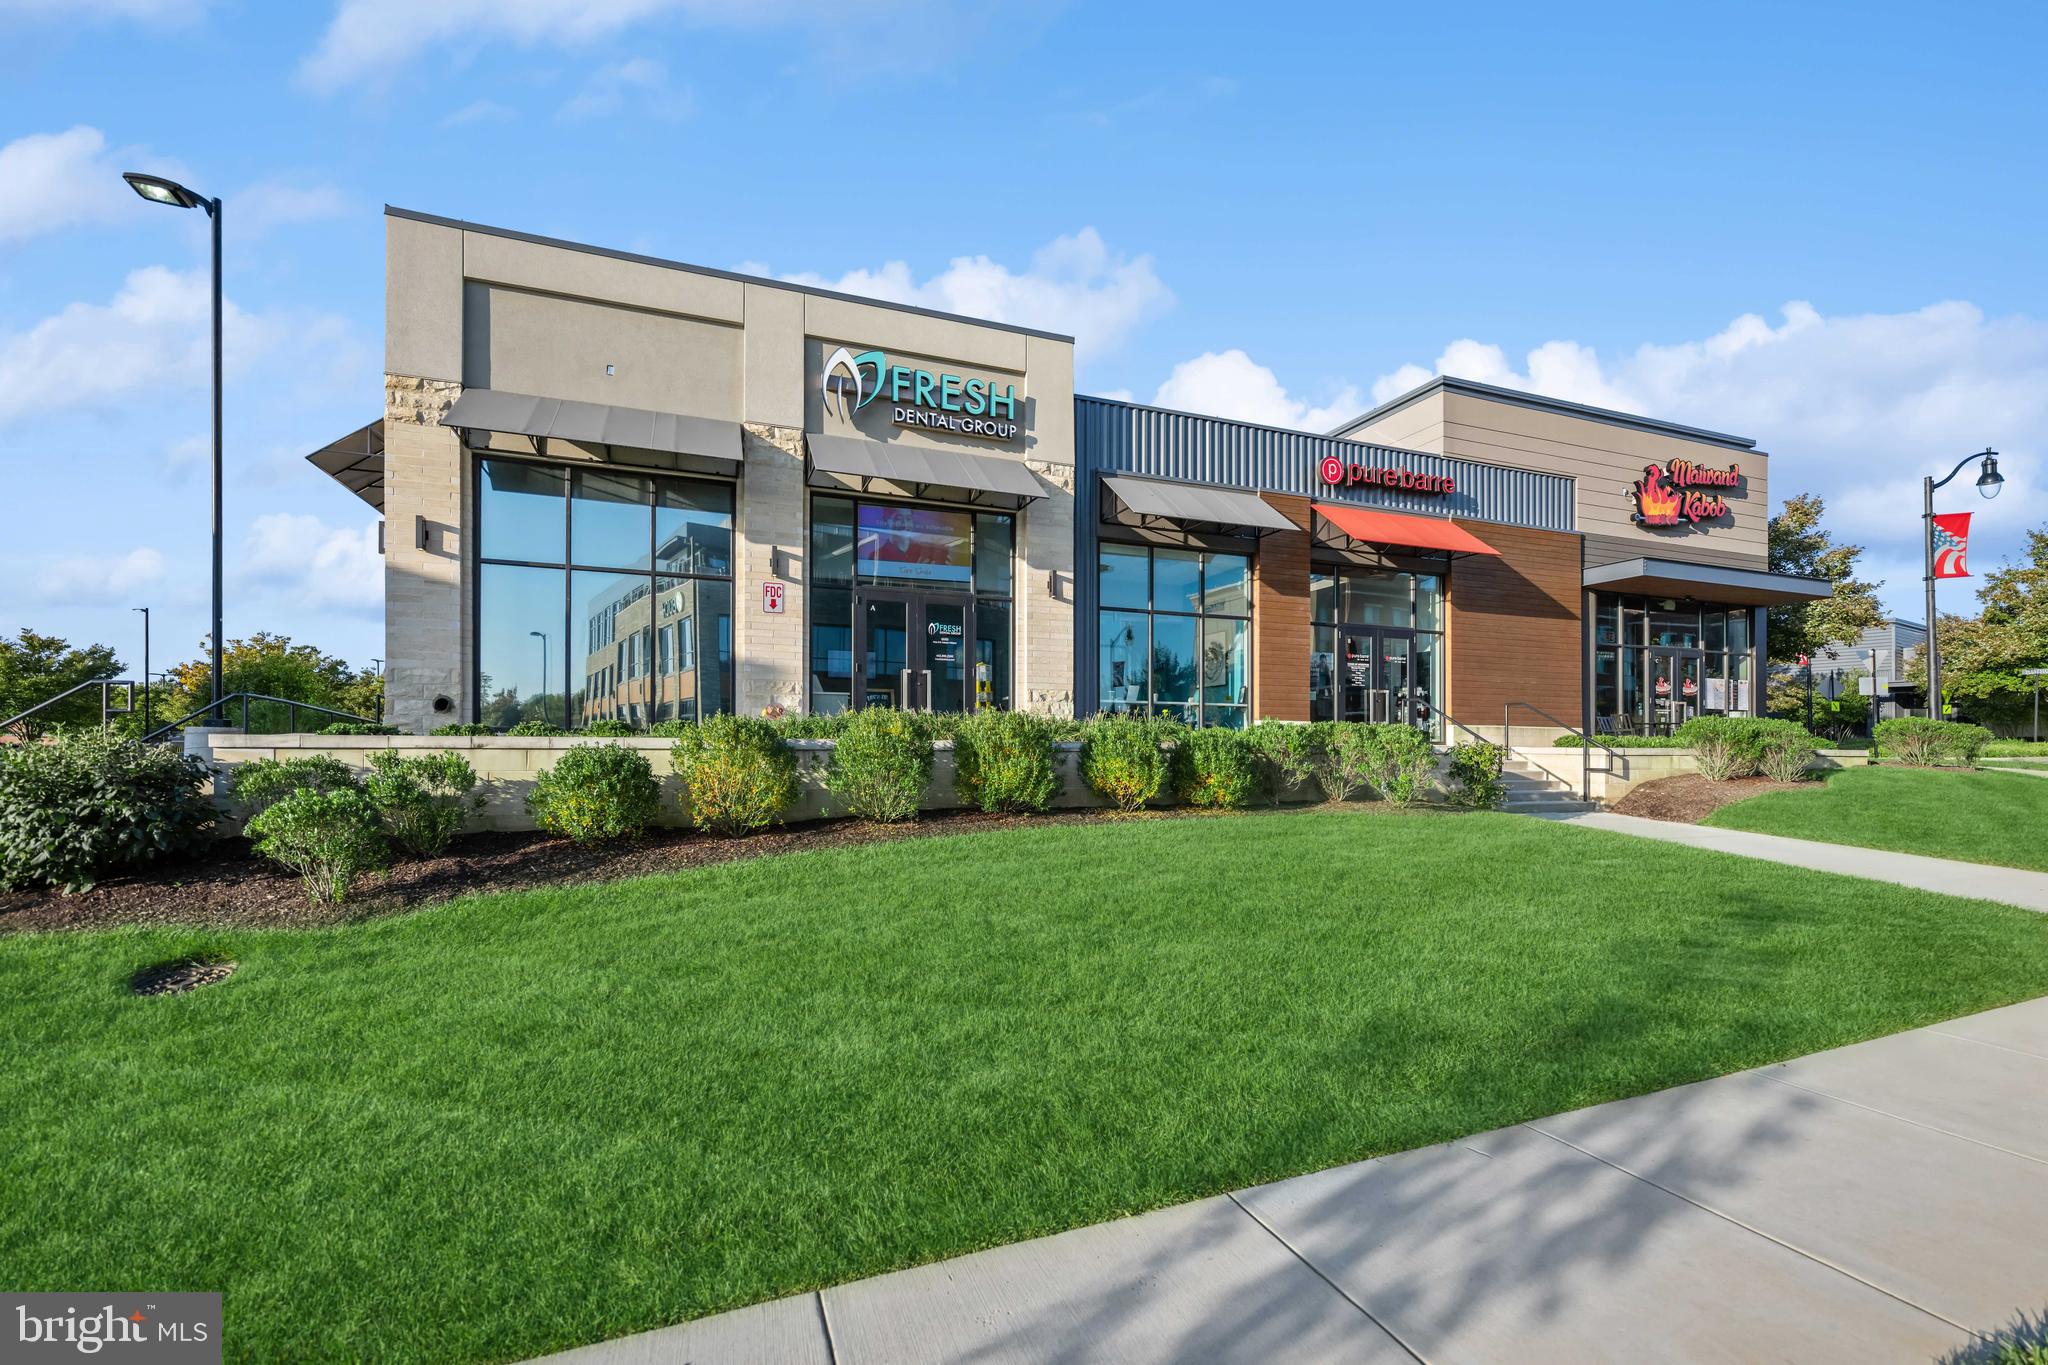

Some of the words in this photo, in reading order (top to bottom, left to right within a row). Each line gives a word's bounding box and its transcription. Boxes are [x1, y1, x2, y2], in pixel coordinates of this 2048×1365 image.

[891, 365, 1015, 420] FRESH
[893, 407, 955, 431] DENTAL
[961, 418, 1017, 438] GROUP
[1347, 463, 1397, 486] pure
[1400, 465, 1456, 494] barre
[1671, 458, 1739, 487] Maiwand
[1683, 490, 1727, 523] Kabob
[765, 586, 782, 598] FDC
[939, 624, 962, 633] FRESH
